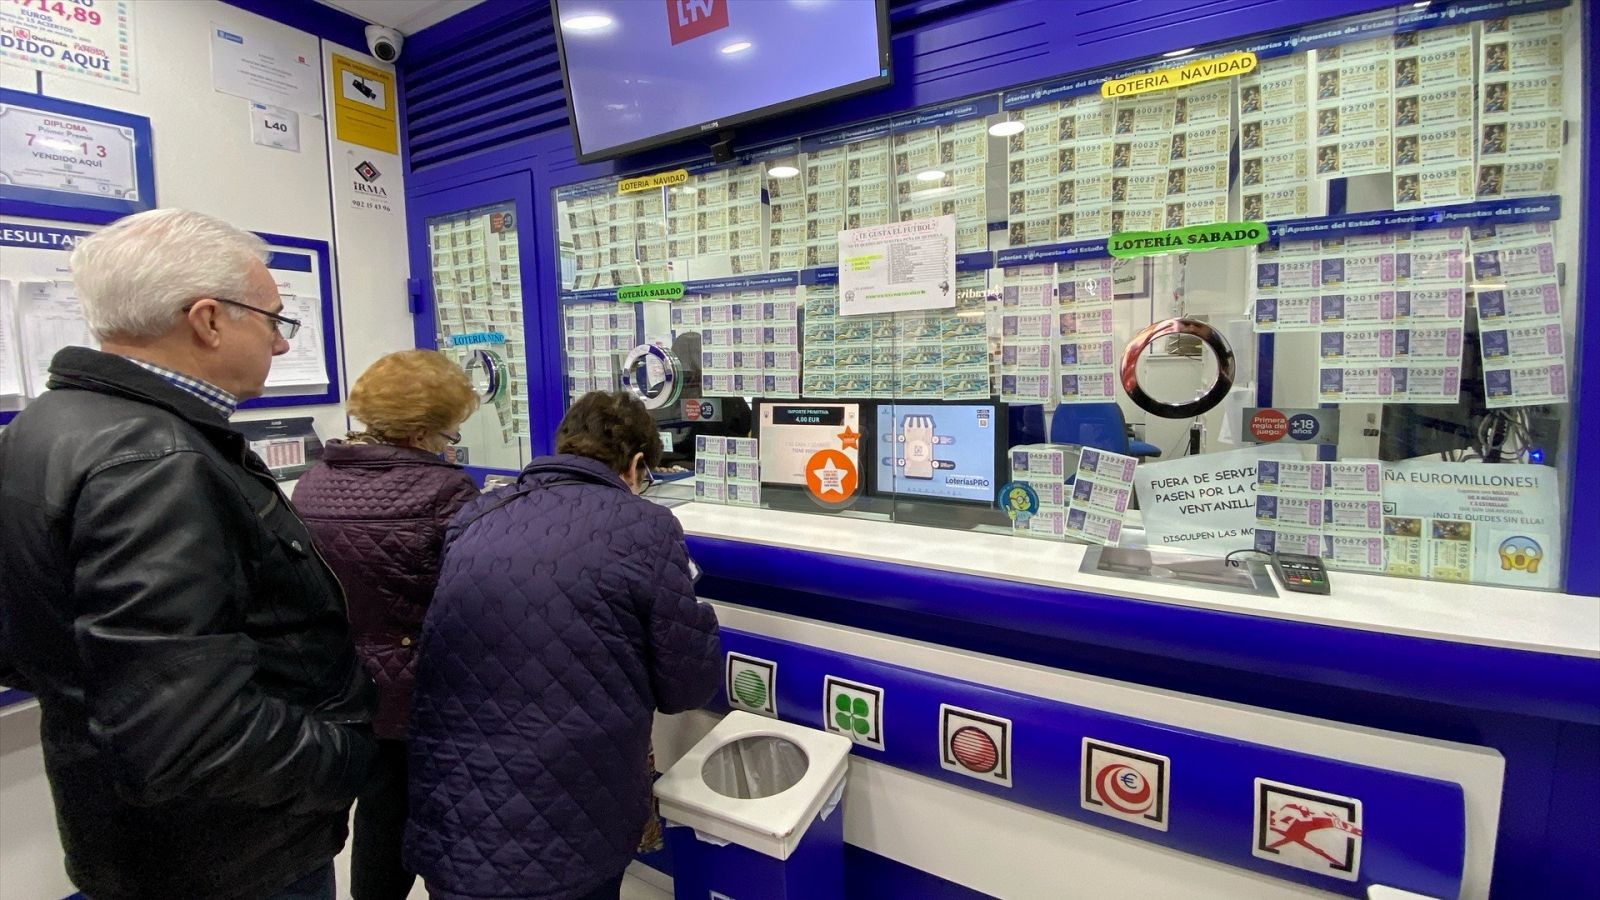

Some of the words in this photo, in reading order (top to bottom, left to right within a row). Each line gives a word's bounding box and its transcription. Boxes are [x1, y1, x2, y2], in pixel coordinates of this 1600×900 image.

[21, 9, 53, 22] EUROS
[61, 49, 111, 72] AQUÍ
[1107, 74, 1169, 96] LOTERIA
[1181, 57, 1252, 81] NAVIDAD
[43, 119, 88, 133] DIPLOMA
[264, 119, 288, 133] L40
[32, 151, 77, 163] VENDIDO
[620, 180, 650, 191] LOTERIA
[653, 173, 686, 186] NAVIDAD
[1287, 225, 1328, 234] Apuestas
[1348, 219, 1381, 228] Estado
[1445, 210, 1493, 220] Apuestas
[1495, 208, 1511, 216] del
[1514, 205, 1551, 214] Estado
[869, 229, 892, 239] GUSTA
[1114, 234, 1183, 251] LOTERÍA
[1187, 229, 1261, 244] SABADO
[619, 288, 648, 299] LOTERÍA
[650, 287, 682, 297] SABADO
[1252, 422, 1273, 430] regla
[1254, 416, 1286, 424] Primera
[1291, 419, 1314, 429] +18
[1151, 476, 1189, 489] FUERA
[1193, 473, 1210, 484] DE
[1410, 471, 1539, 489] EUROMILLONES!
[1155, 490, 1195, 503] PASEN
[1199, 487, 1224, 498] POR
[1228, 483, 1245, 495] LA
[1452, 512, 1464, 520] TE
[1465, 513, 1502, 523] QUEDES
[1503, 514, 1518, 524] SIN
[1520, 516, 1544, 525] ELLA!
[1163, 532, 1215, 543] DISCULPEN
[1218, 529, 1237, 539] LAS
